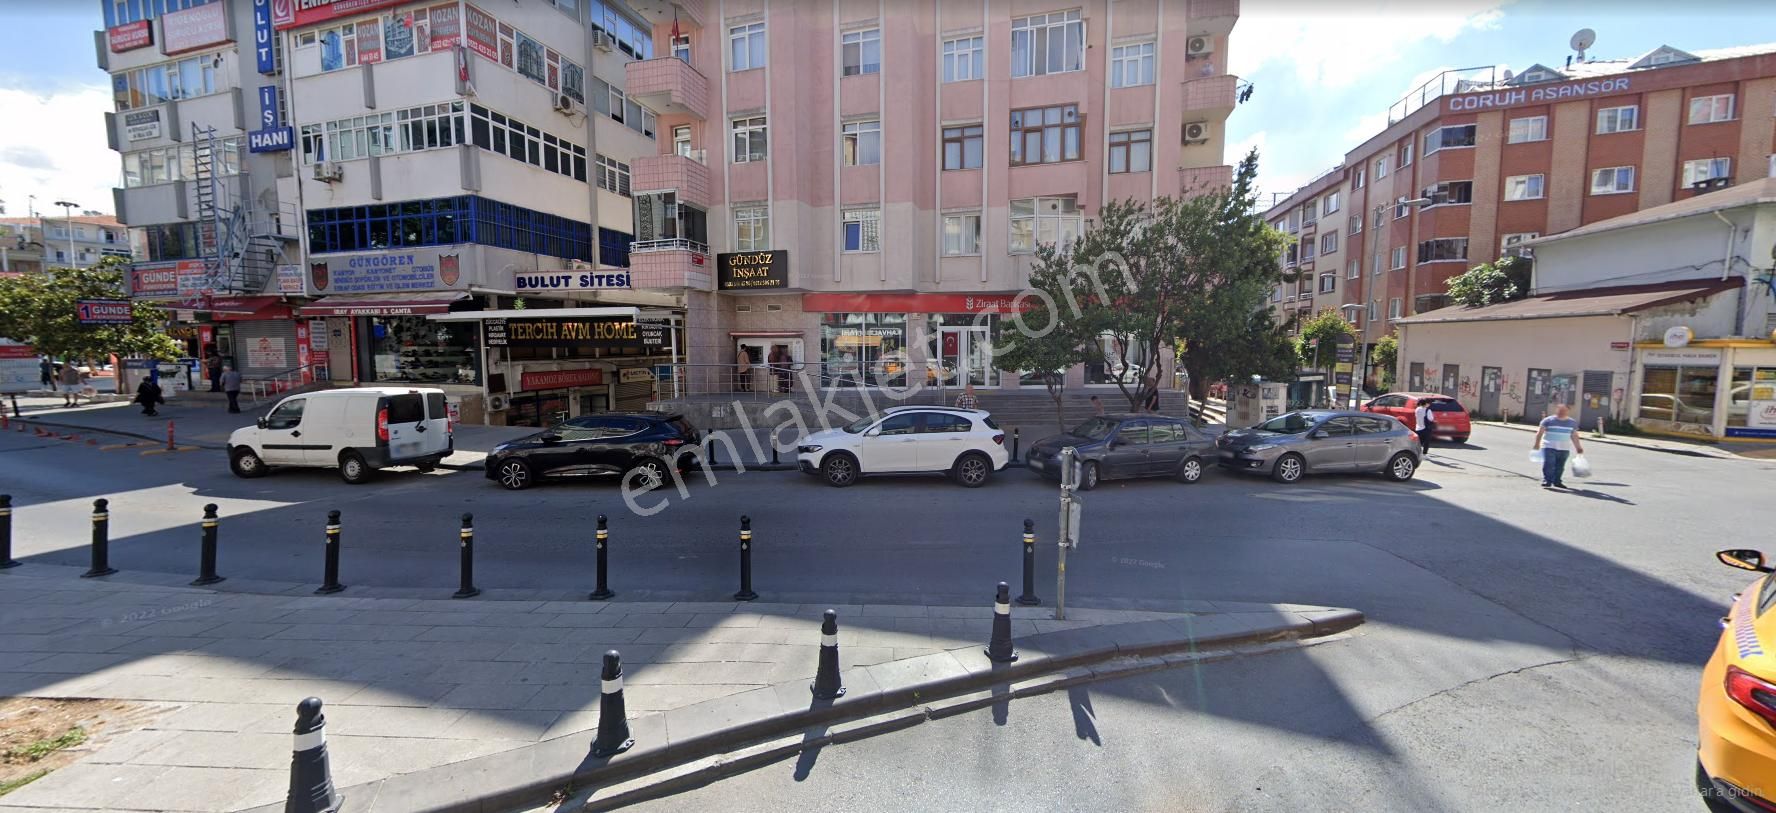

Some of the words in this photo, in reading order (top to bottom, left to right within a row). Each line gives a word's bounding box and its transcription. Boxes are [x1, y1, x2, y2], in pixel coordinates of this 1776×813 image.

[431, 7, 459, 24] KOZAN
[467, 7, 495, 33] KOZAN
[357, 23, 379, 39] KOZAN
[263, 88, 274, 127] İŞ
[251, 131, 288, 148] HANI
[349, 254, 414, 268] GÜNGÖREN
[729, 252, 773, 266] GÜNDÜZ
[143, 270, 176, 284] GÜNDE
[516, 275, 572, 289] BULUT
[579, 271, 631, 288] SİTESİ
[733, 266, 769, 279] İNŞAAT
[92, 304, 130, 315] GÜNDE
[976, 299, 999, 308] Ziraat
[508, 318, 558, 340] TERCİH
[560, 322, 591, 339] AVM
[594, 322, 637, 339] HOME
